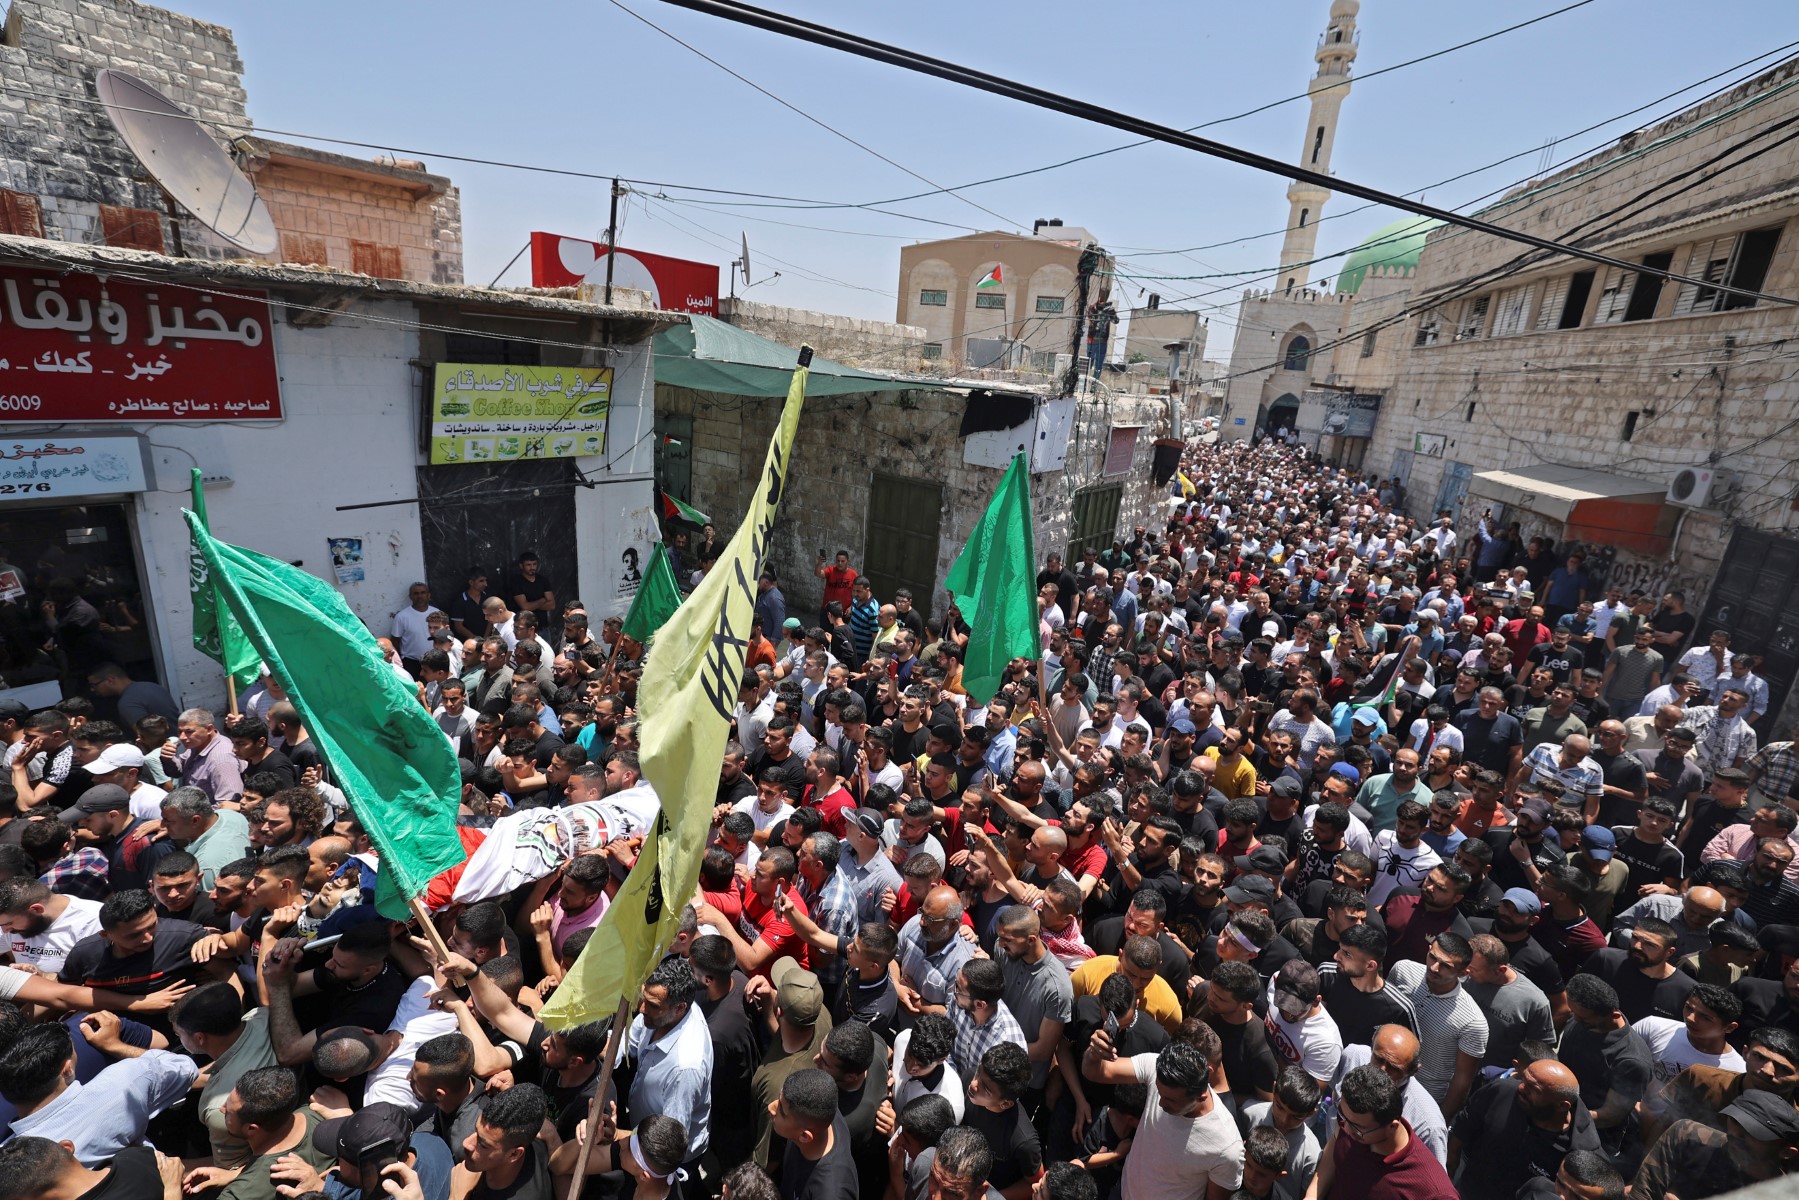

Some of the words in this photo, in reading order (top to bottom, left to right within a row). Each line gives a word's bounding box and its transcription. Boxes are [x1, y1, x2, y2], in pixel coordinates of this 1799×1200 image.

[0, 278, 128, 345] وبقا
[686, 294, 713, 308] الأمين
[145, 293, 263, 348] مخبز
[34, 350, 93, 373] كعك
[124, 352, 173, 381] خبز
[445, 368, 523, 393] الأصدقاء
[526, 373, 562, 396] شوب
[565, 374, 608, 399] كوفي
[172, 399, 210, 415] صالح
[473, 398, 531, 416] Coffee
[534, 399, 576, 419] Shop
[497, 423, 521, 432] ساخنة
[528, 423, 545, 433] باردة
[546, 422, 576, 433] مشروبات
[2, 443, 85, 460] مخبز
[1542, 655, 1569, 671] Lee
